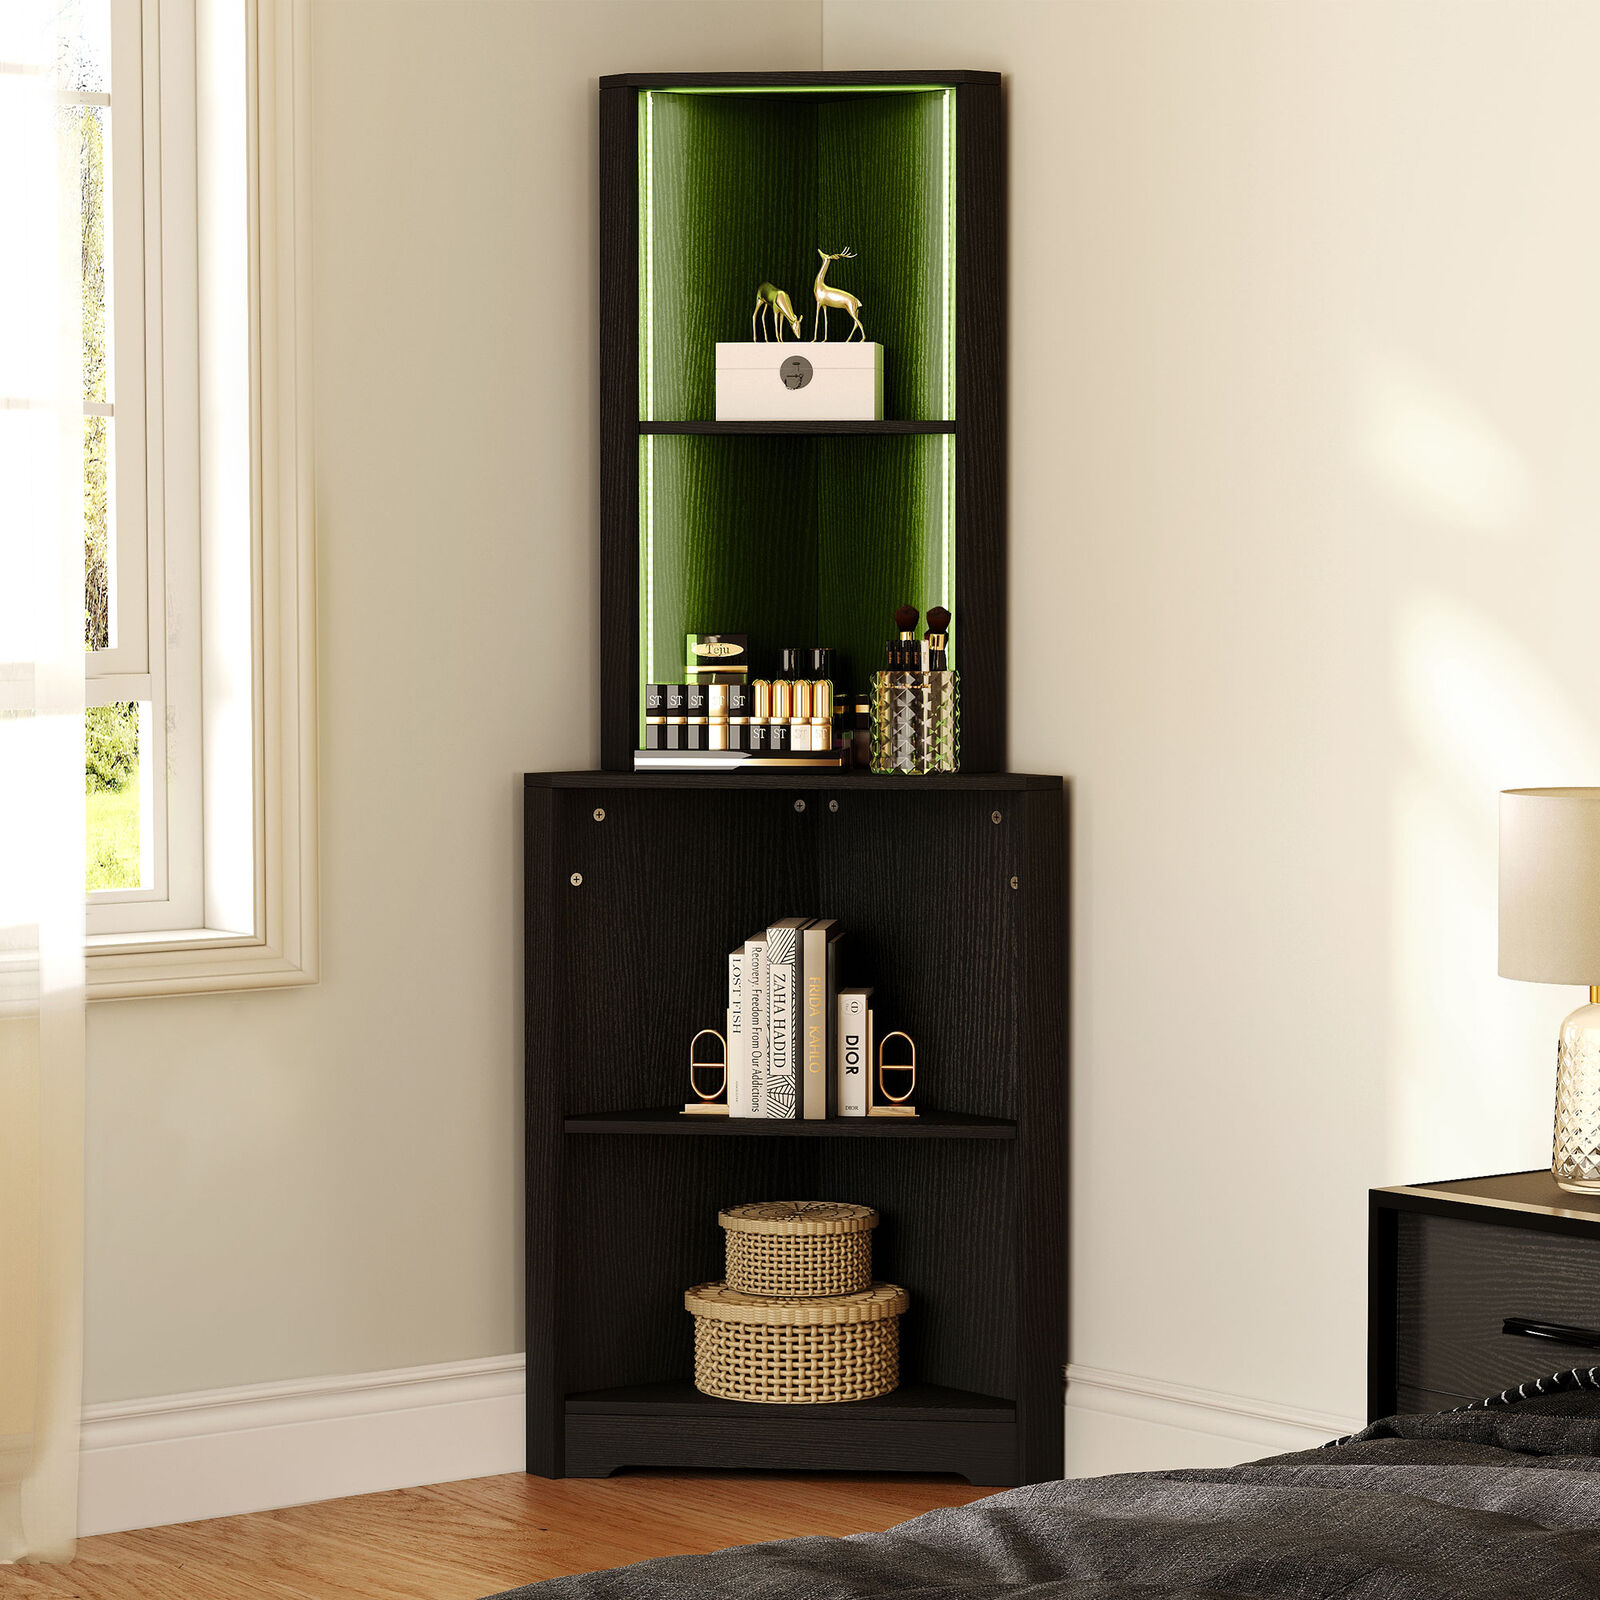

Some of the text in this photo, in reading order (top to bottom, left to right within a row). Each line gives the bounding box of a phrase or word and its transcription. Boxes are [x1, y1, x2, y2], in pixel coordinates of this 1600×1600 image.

[705, 643, 730, 657] Teju
[649, 695, 662, 706] ST
[669, 695, 683, 706] ST
[690, 695, 704, 706] ST
[732, 695, 746, 706] ST
[753, 728, 766, 739] ST
[773, 728, 787, 739] ST
[732, 958, 742, 1034] LOST FISH
[751, 989, 763, 1026] Freedom
[773, 973, 786, 1068] ZAHA HADID
[808, 976, 821, 1073] FRIDA KAHLO
[751, 1028, 763, 1049] From
[751, 1051, 763, 1068] Our
[845, 1035, 859, 1075] DIOR
[751, 1068, 764, 1113] Addictions
